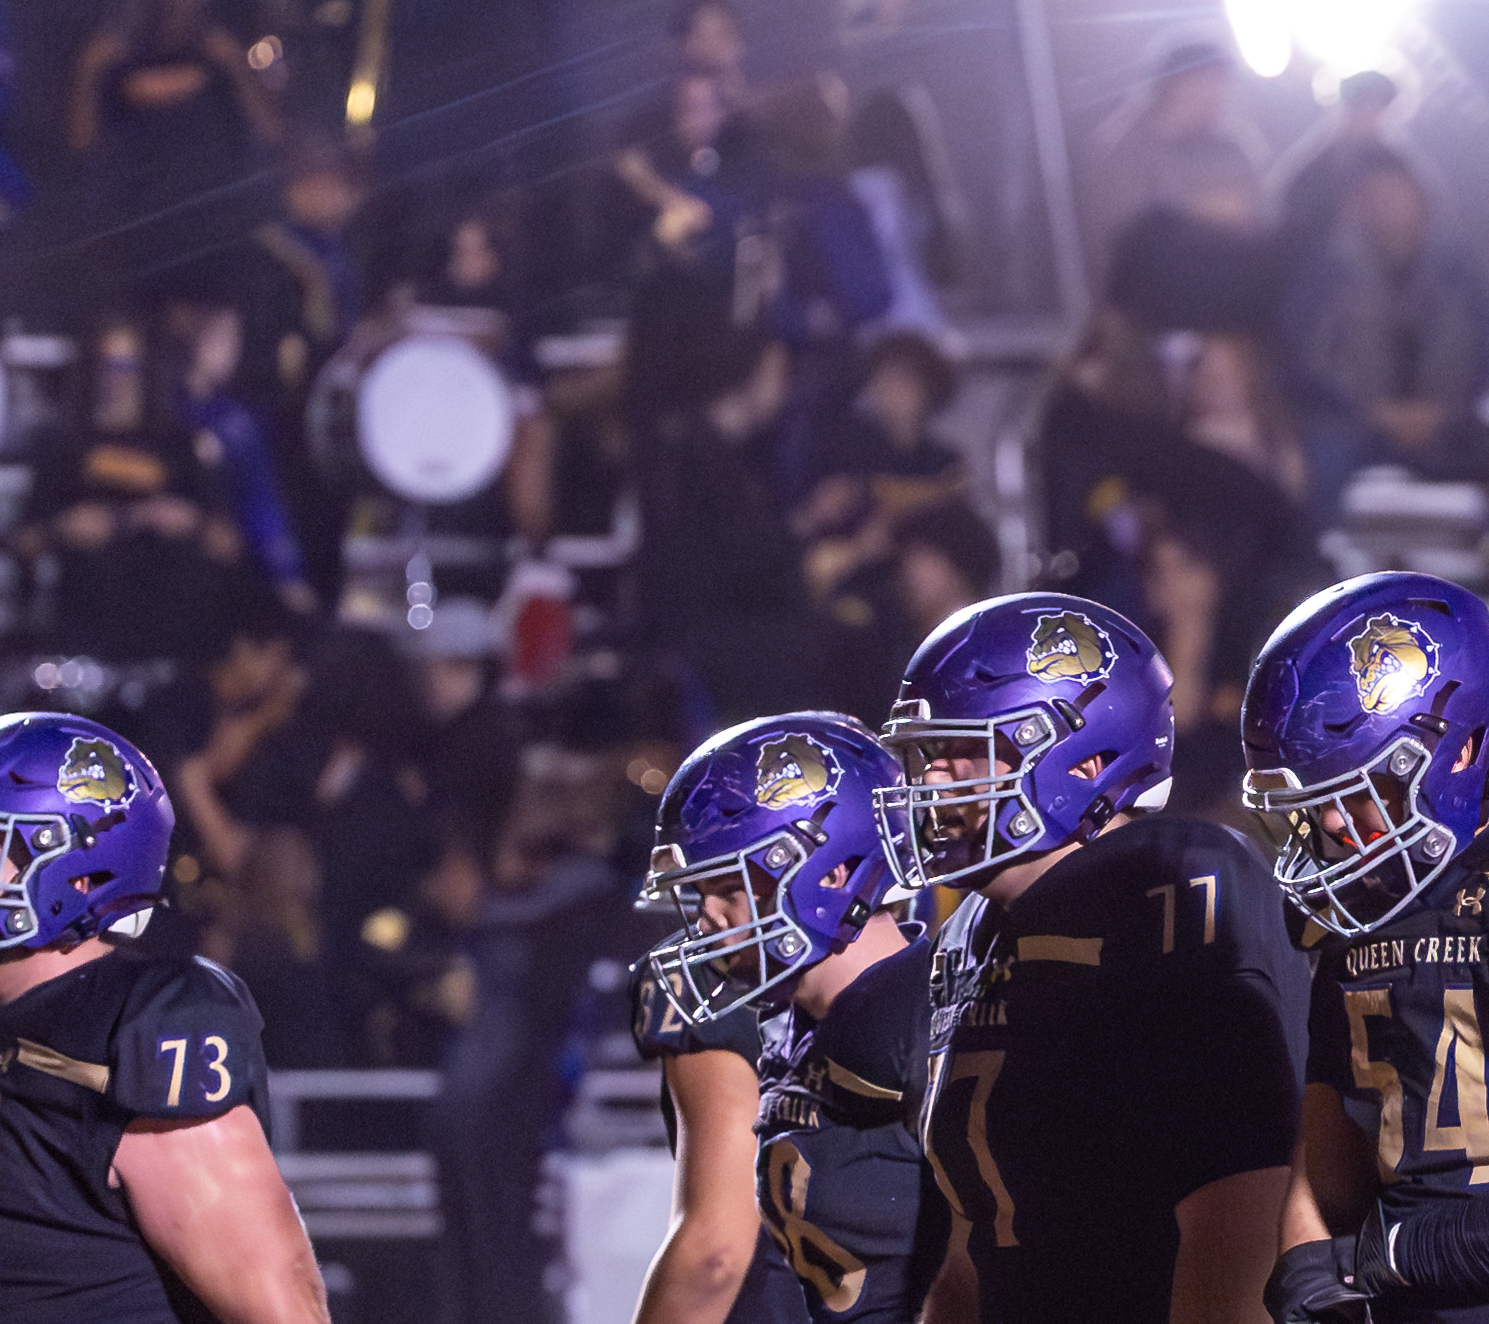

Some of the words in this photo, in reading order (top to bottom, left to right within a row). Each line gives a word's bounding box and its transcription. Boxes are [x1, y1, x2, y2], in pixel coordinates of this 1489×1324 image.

[1145, 874, 1216, 955] 77
[1345, 939, 1405, 977] QUEEN
[1413, 935, 1482, 964] CREEK
[159, 1036, 231, 1108] 73
